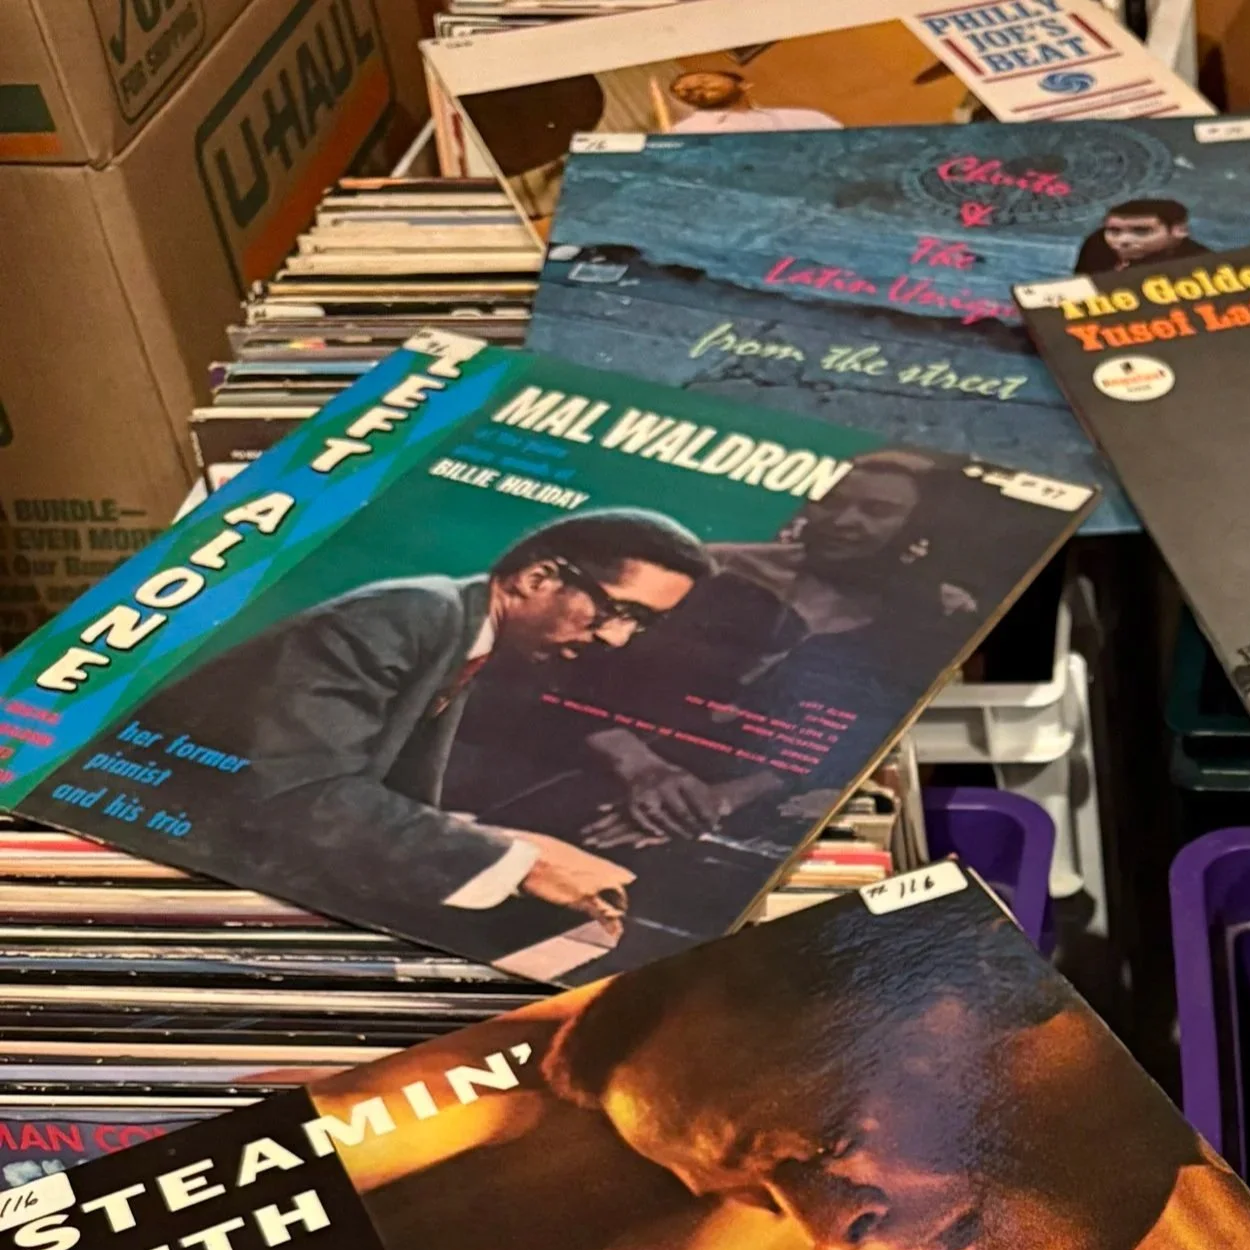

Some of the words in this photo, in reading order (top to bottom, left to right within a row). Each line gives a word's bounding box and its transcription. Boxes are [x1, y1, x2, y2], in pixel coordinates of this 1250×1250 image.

[923, 0, 1064, 36] PHILLY
[980, 36, 1089, 73] BEAT
[1067, 308, 1197, 352] Yusef
[689, 322, 805, 361] from
[821, 344, 888, 376] the
[899, 360, 1028, 400] street
[492, 386, 610, 443] MAL
[602, 407, 853, 501] WALDRON
[428, 458, 501, 488] BILLIE
[496, 473, 590, 510] HOLIDAY
[35, 490, 296, 692] ALONE
[82, 751, 172, 786] pianist
[117, 720, 164, 748] her
[164, 734, 251, 774] former
[52, 783, 108, 808] and
[103, 793, 145, 823] his
[147, 810, 192, 837] trio
